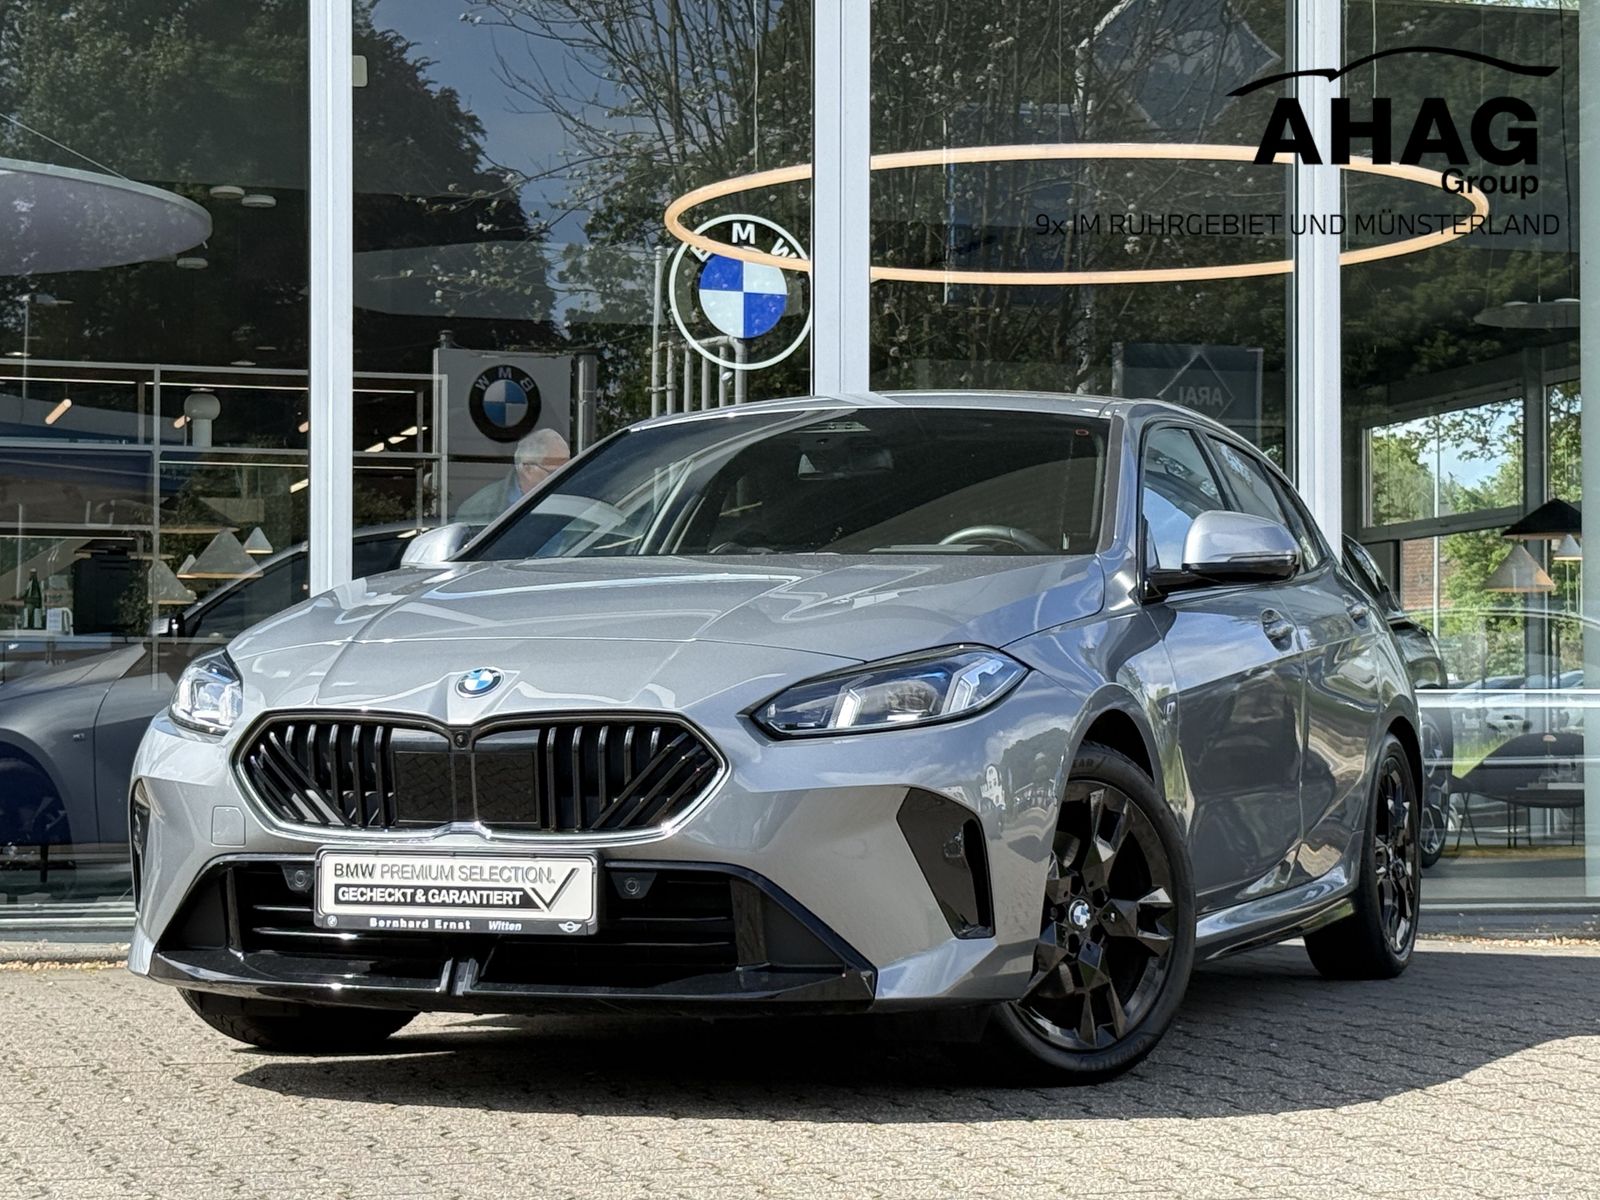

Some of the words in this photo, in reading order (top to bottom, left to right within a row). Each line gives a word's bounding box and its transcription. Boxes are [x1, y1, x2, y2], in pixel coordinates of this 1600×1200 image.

[334, 863, 376, 879] BMW
[381, 864, 455, 881] PREMIUM
[338, 887, 414, 903] GECHECKT
[415, 889, 426, 903] &
[428, 889, 524, 906] GARANTIERT
[488, 920, 522, 931] Witten
